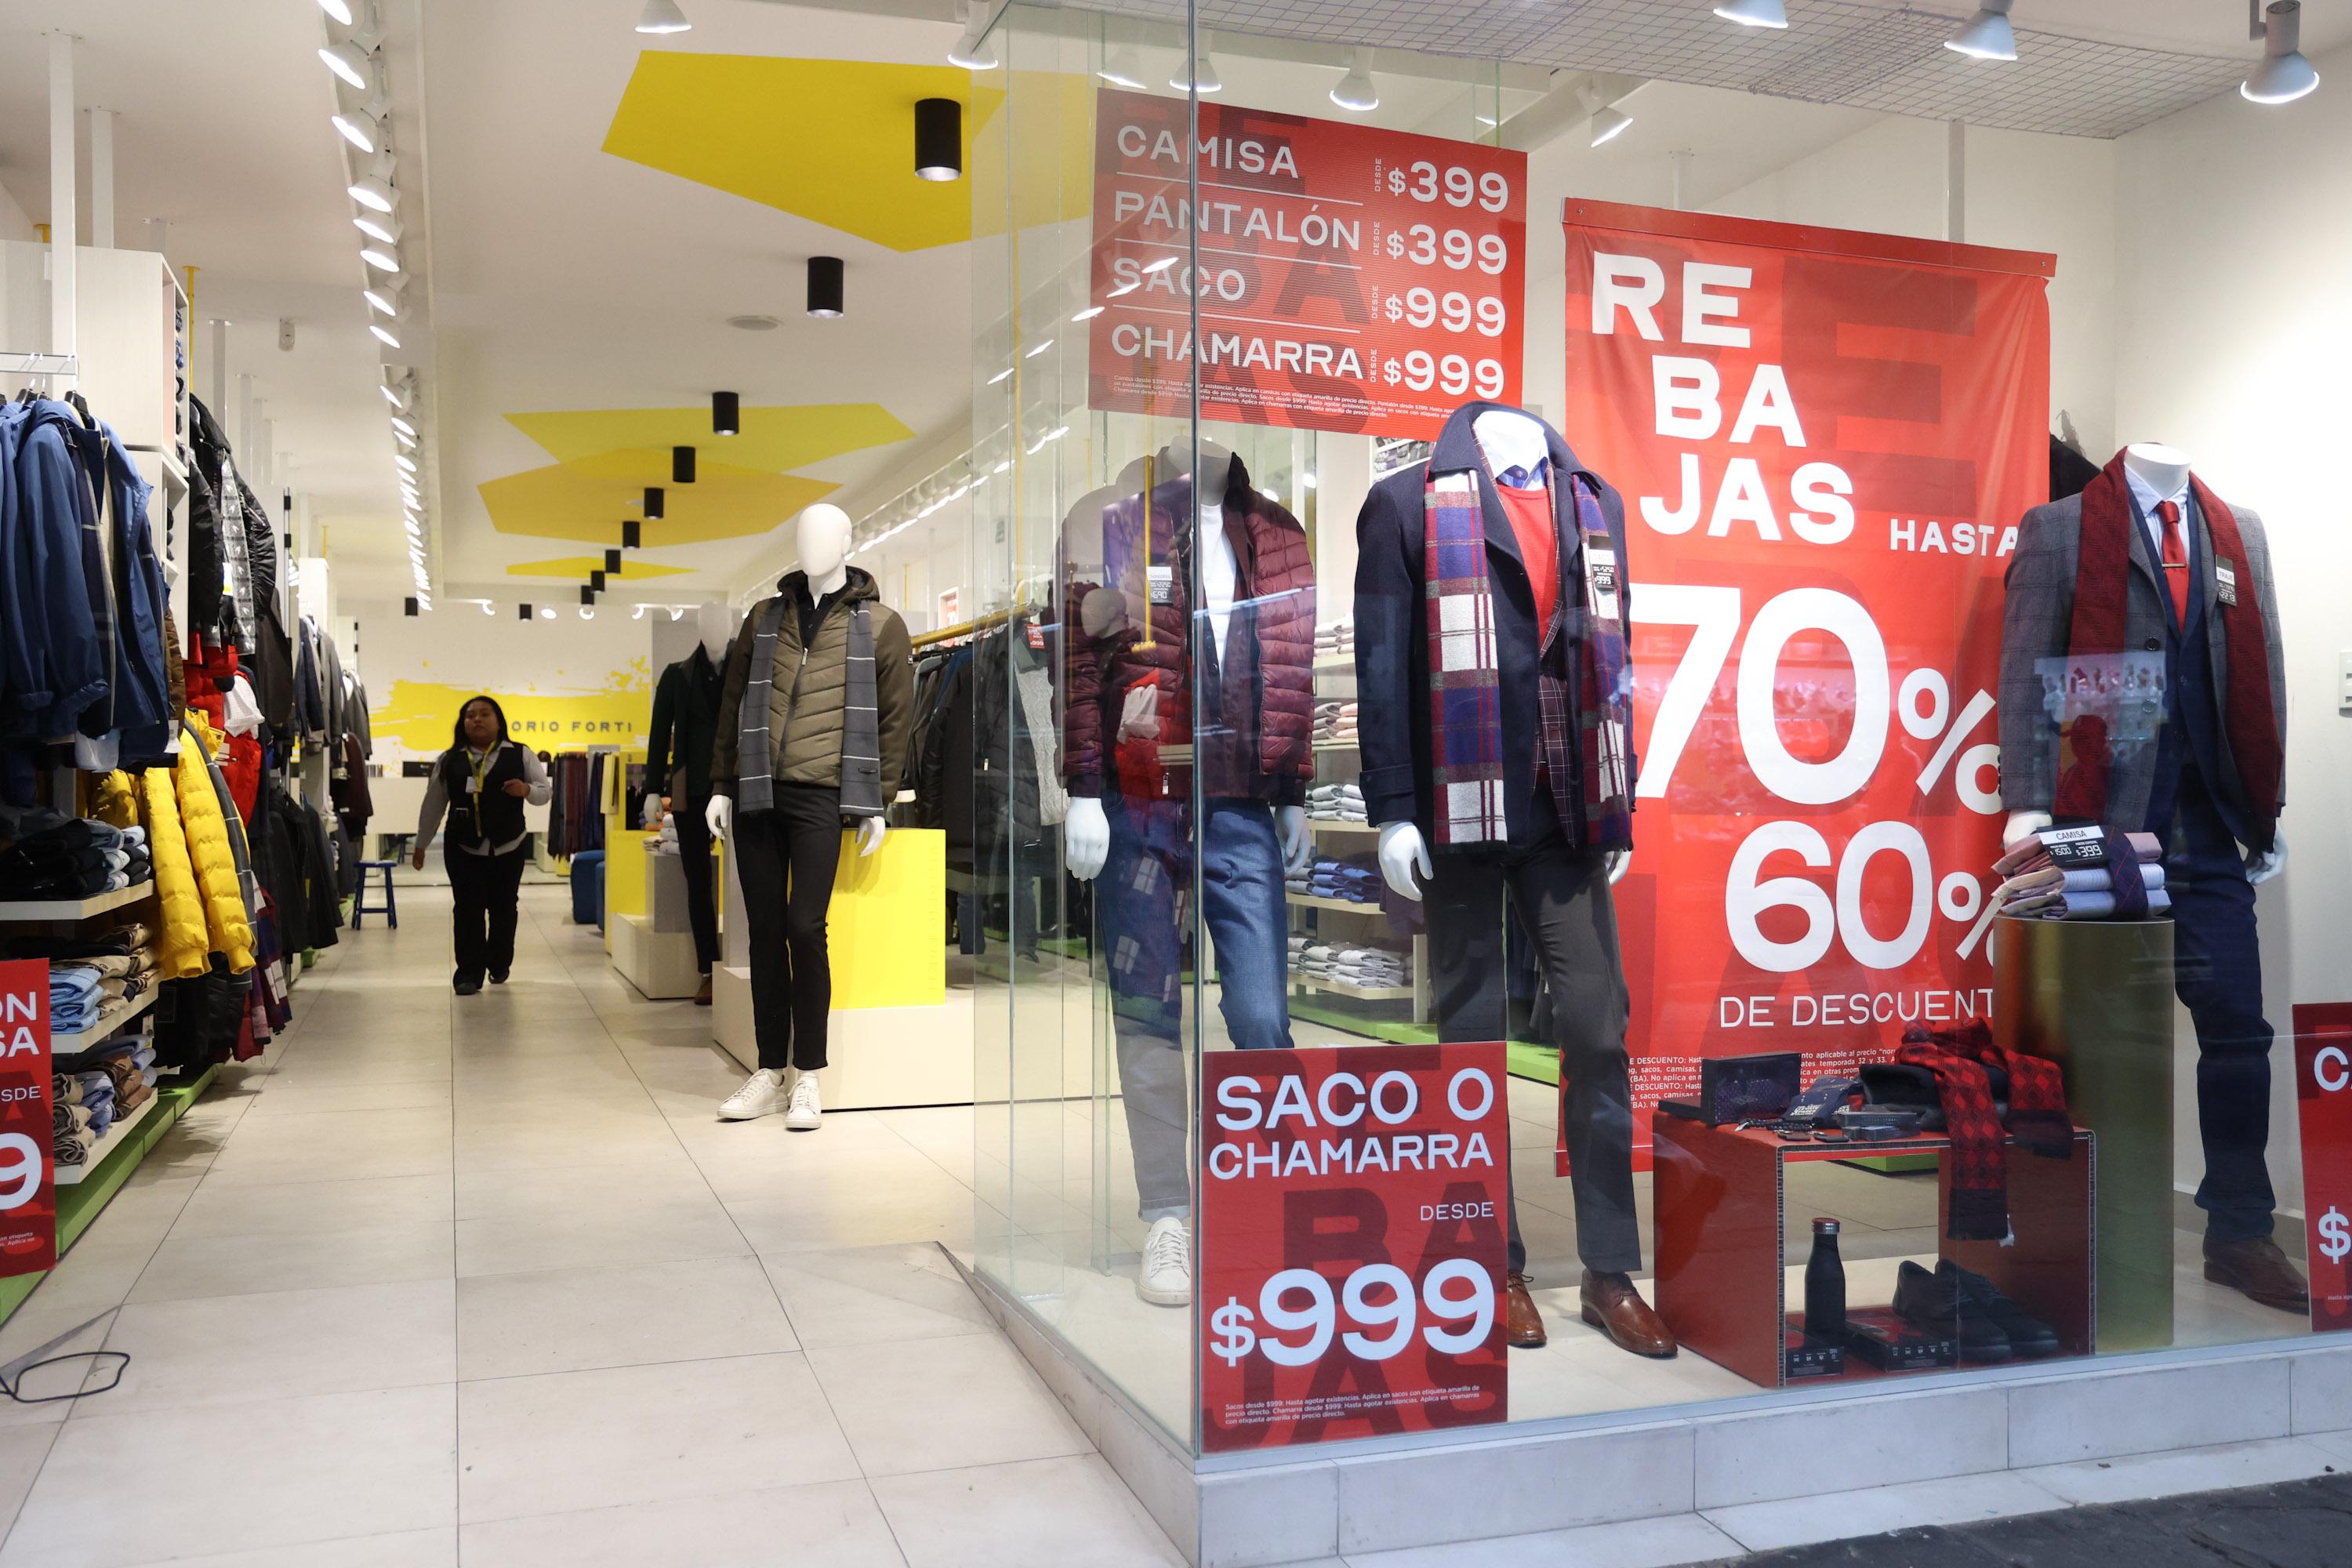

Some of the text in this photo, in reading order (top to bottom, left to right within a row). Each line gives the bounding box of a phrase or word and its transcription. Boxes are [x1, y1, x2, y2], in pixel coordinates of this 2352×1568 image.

[1116, 125, 1299, 179] CAMISA
[1388, 161, 1508, 212] $399
[1115, 191, 1360, 251] PANTALÓN
[1386, 223, 1507, 274] $399
[1113, 258, 1246, 301] SACO
[1592, 251, 1753, 348] RE
[1385, 287, 1506, 337] $999
[1111, 325, 1364, 380] CHAMARRA
[1383, 350, 1504, 399] $999
[1652, 354, 1806, 448] BA
[1640, 452, 1855, 544] JAS
[1889, 518, 2020, 557] HASTA
[1628, 583, 2002, 815] 70%
[511, 720, 632, 732] ORIO FORTI
[2056, 830, 2087, 840] CAMISA
[2075, 844, 2103, 858] $399
[1726, 820, 2003, 973] 60%
[1719, 989, 1994, 1027] DE DESCUENT
[1663, 1073, 1686, 1082] aplica
[1816, 1050, 1847, 1059] aplicable
[1857, 1049, 1877, 1058] precio
[1819, 1058, 1856, 1068] temporada
[1215, 1067, 1494, 1131] SACO O
[1209, 1132, 1494, 1180] CHAMARRA
[1420, 1201, 1494, 1221] DESDE
[1210, 1258, 1495, 1367] $999
